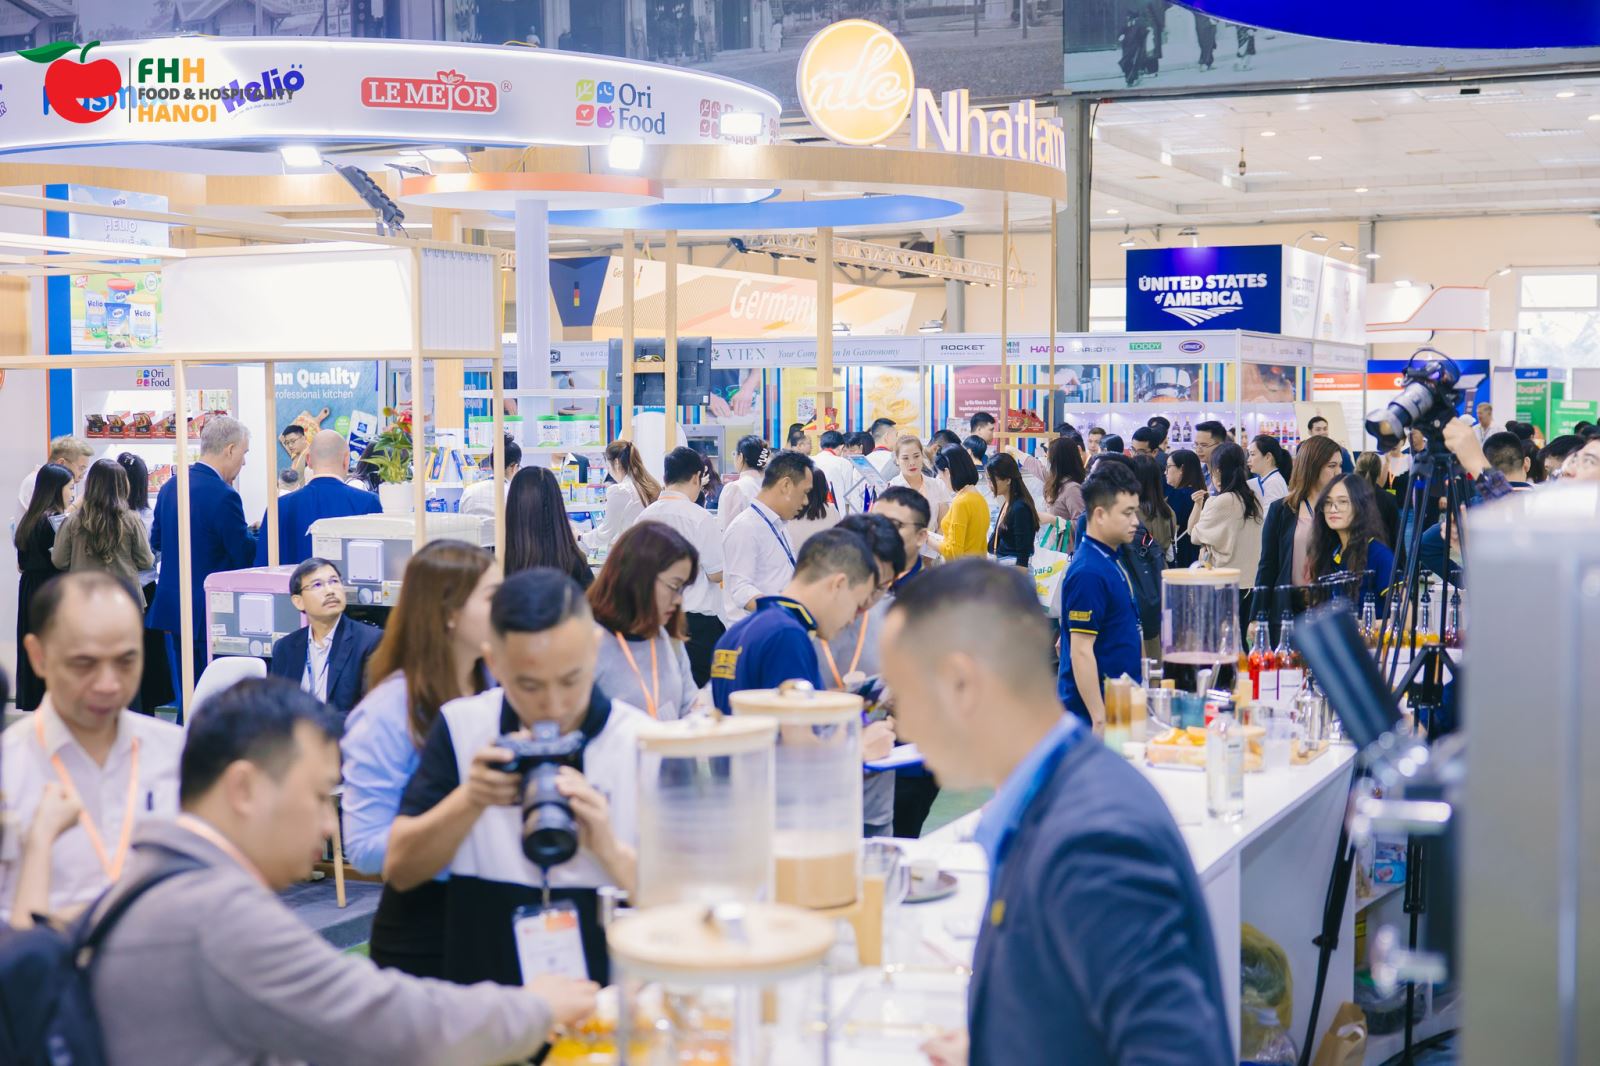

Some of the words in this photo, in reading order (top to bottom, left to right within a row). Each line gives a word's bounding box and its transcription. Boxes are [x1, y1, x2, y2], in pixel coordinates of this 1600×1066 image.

[368, 81, 401, 103] LE
[404, 82, 493, 112] MEJOR
[618, 83, 652, 108] Ori
[618, 107, 666, 135] Food
[912, 88, 1066, 170] Nhatlam
[1138, 274, 1204, 292] UNITED
[1205, 273, 1268, 289] STATES
[1154, 292, 1166, 305] of
[1163, 290, 1244, 307] AMERICA
[778, 349, 795, 359] Your
[842, 348, 851, 357] In
[150, 369, 165, 378] Ori
[150, 378, 171, 388] Food
[296, 366, 361, 389] Quality
[322, 389, 353, 399] kitchen
